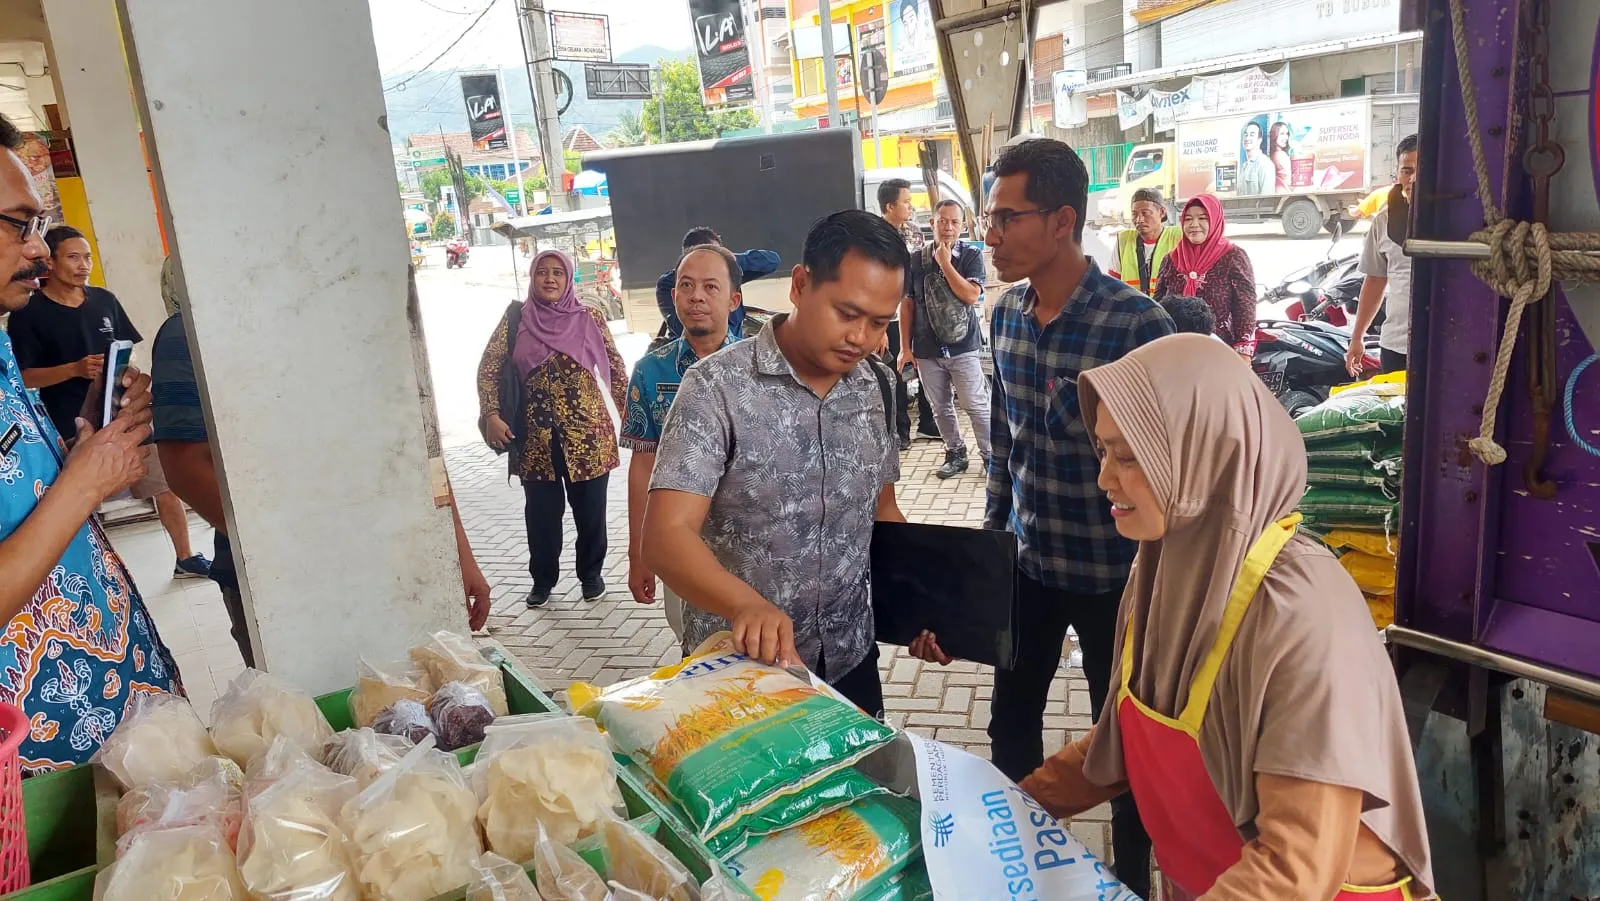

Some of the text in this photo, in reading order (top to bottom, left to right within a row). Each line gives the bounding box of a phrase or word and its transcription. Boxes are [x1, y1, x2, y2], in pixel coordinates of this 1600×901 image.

[1319, 124, 1359, 135] SUPERSILK
[1182, 138, 1218, 148] SUNGUARD
[1317, 132, 1360, 143] ANTI NODA
[1182, 146, 1218, 156] ALL-IN-ONE
[729, 706, 746, 720] 5
